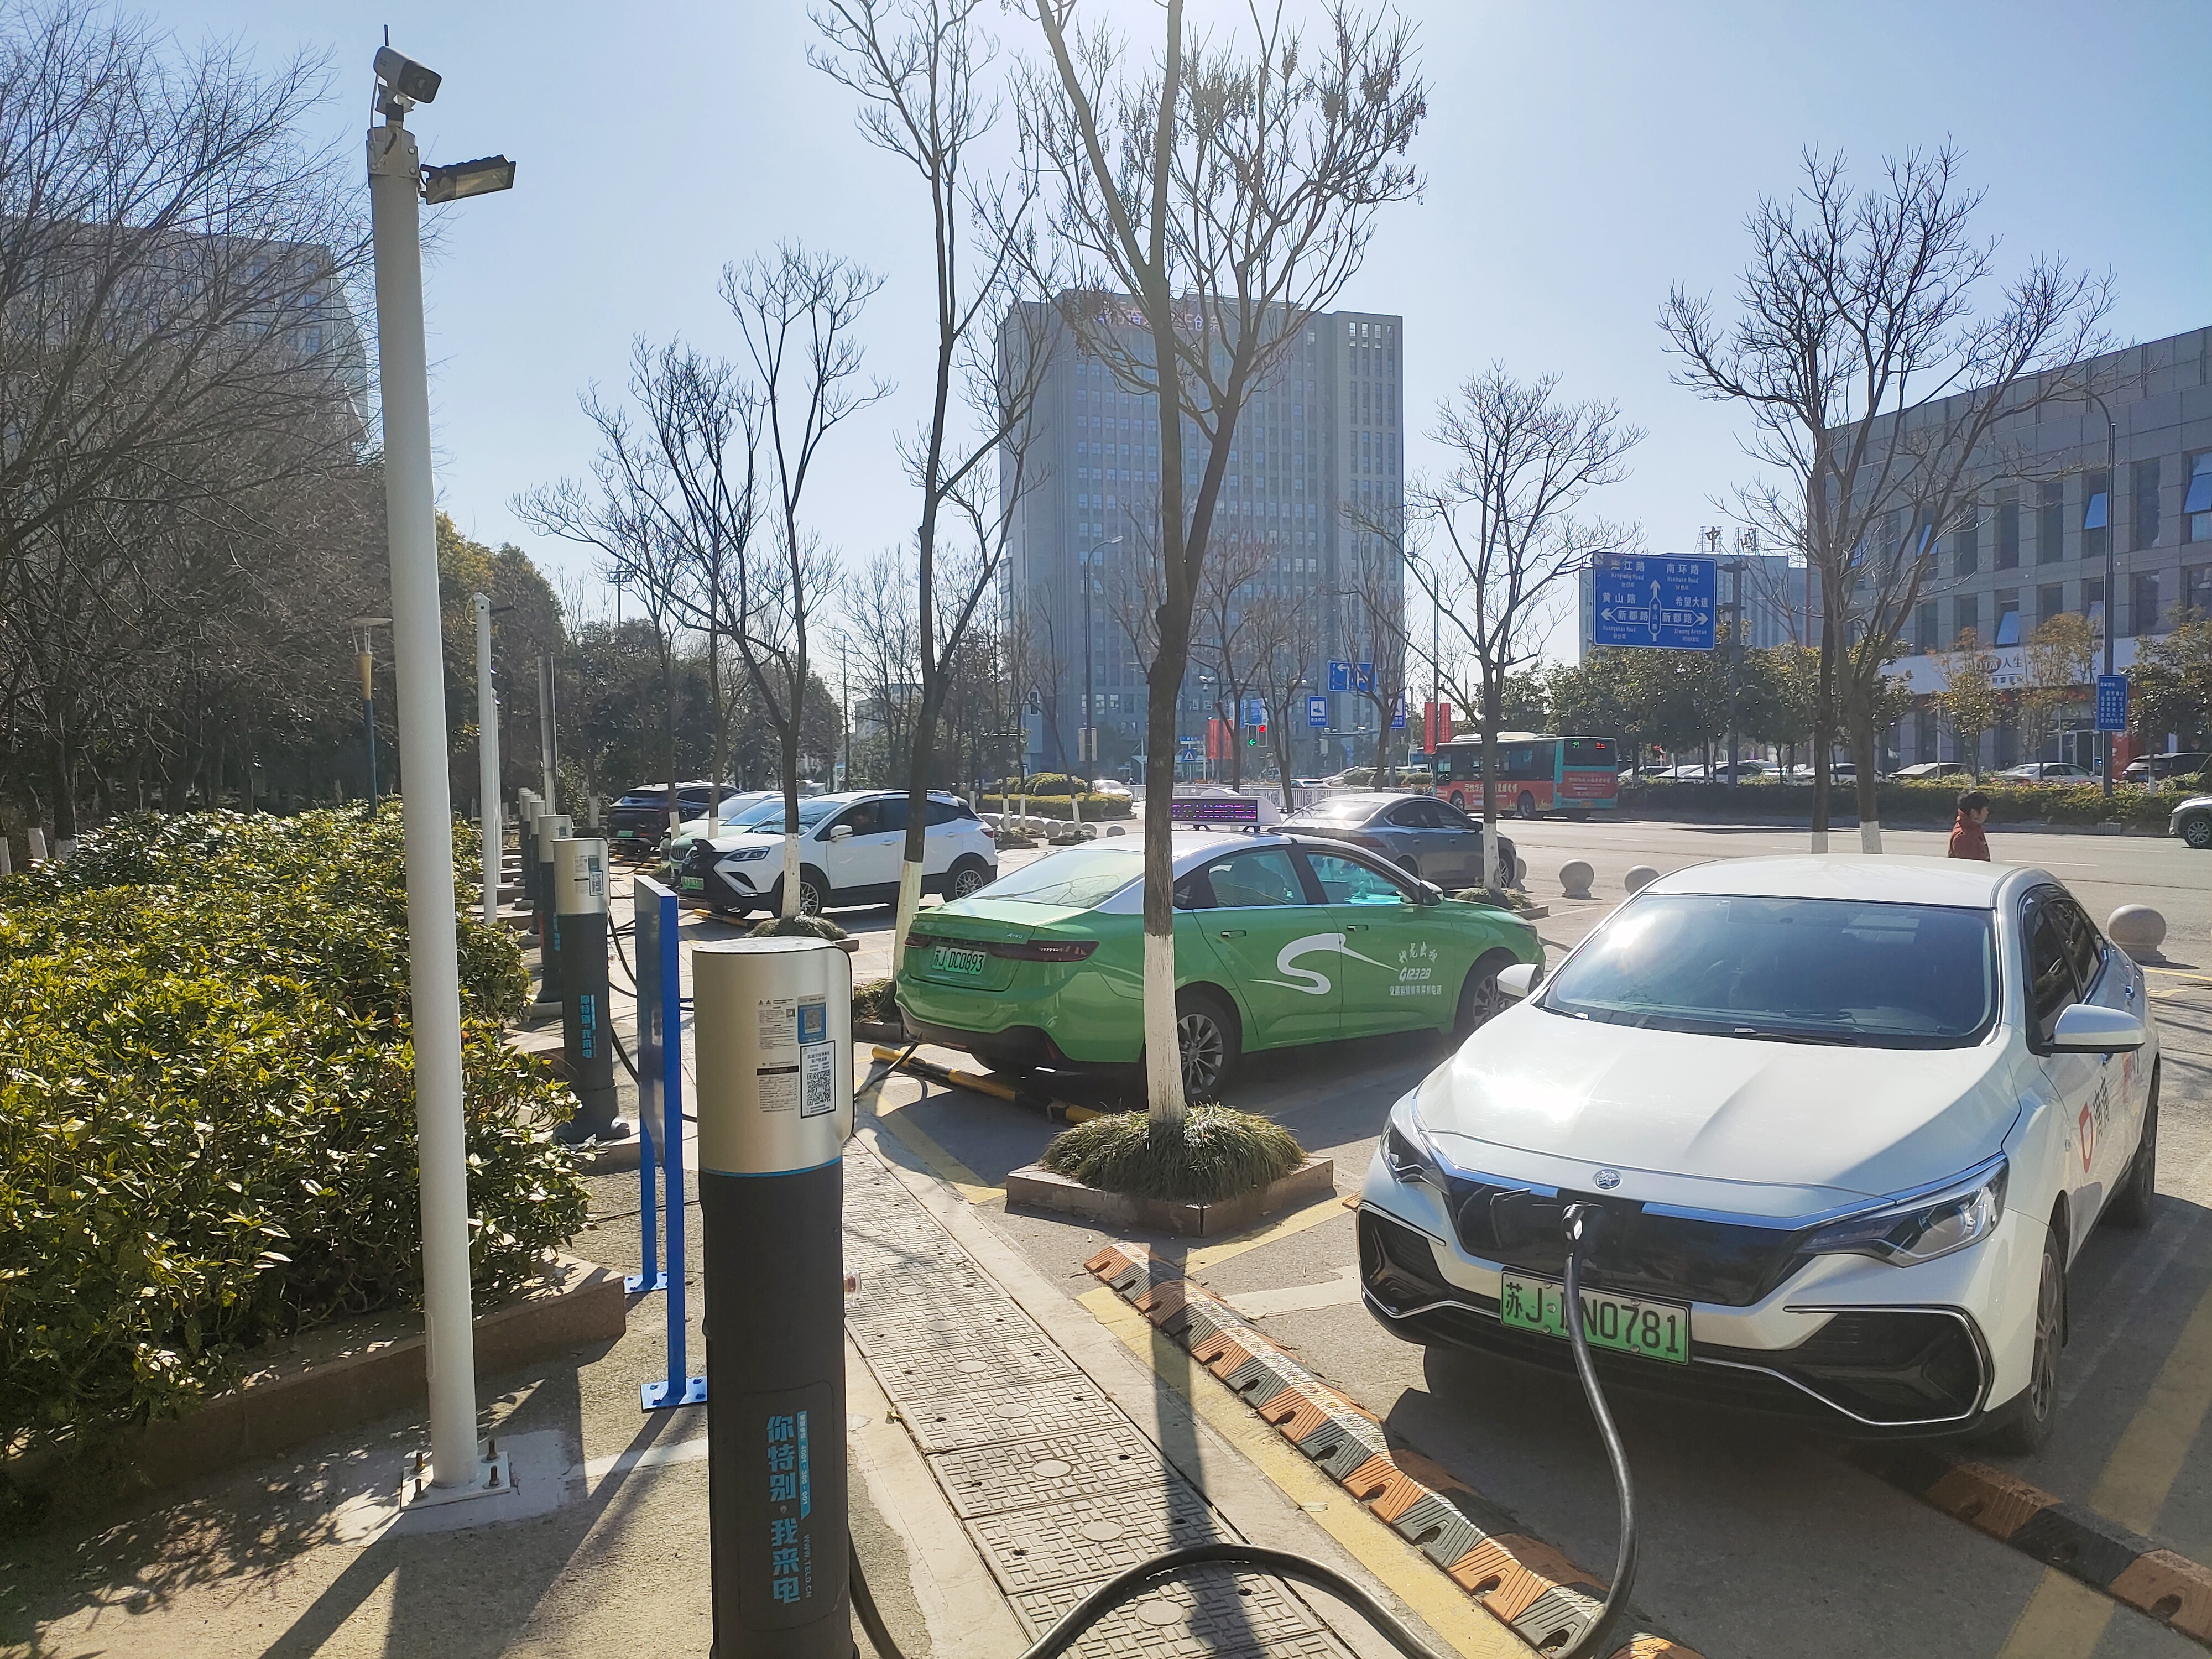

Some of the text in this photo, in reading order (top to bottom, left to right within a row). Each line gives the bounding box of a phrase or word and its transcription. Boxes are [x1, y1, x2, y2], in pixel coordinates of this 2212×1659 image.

[1666, 562, 1699, 575] 南环路
[1603, 592, 1636, 604] 黄山路
[1675, 596, 1709, 608] 希望大道
[1618, 610, 1648, 622] 新都路
[1662, 612, 1693, 624] 新都路
[803, 1533, 812, 1598] WWW.TELD.CN
